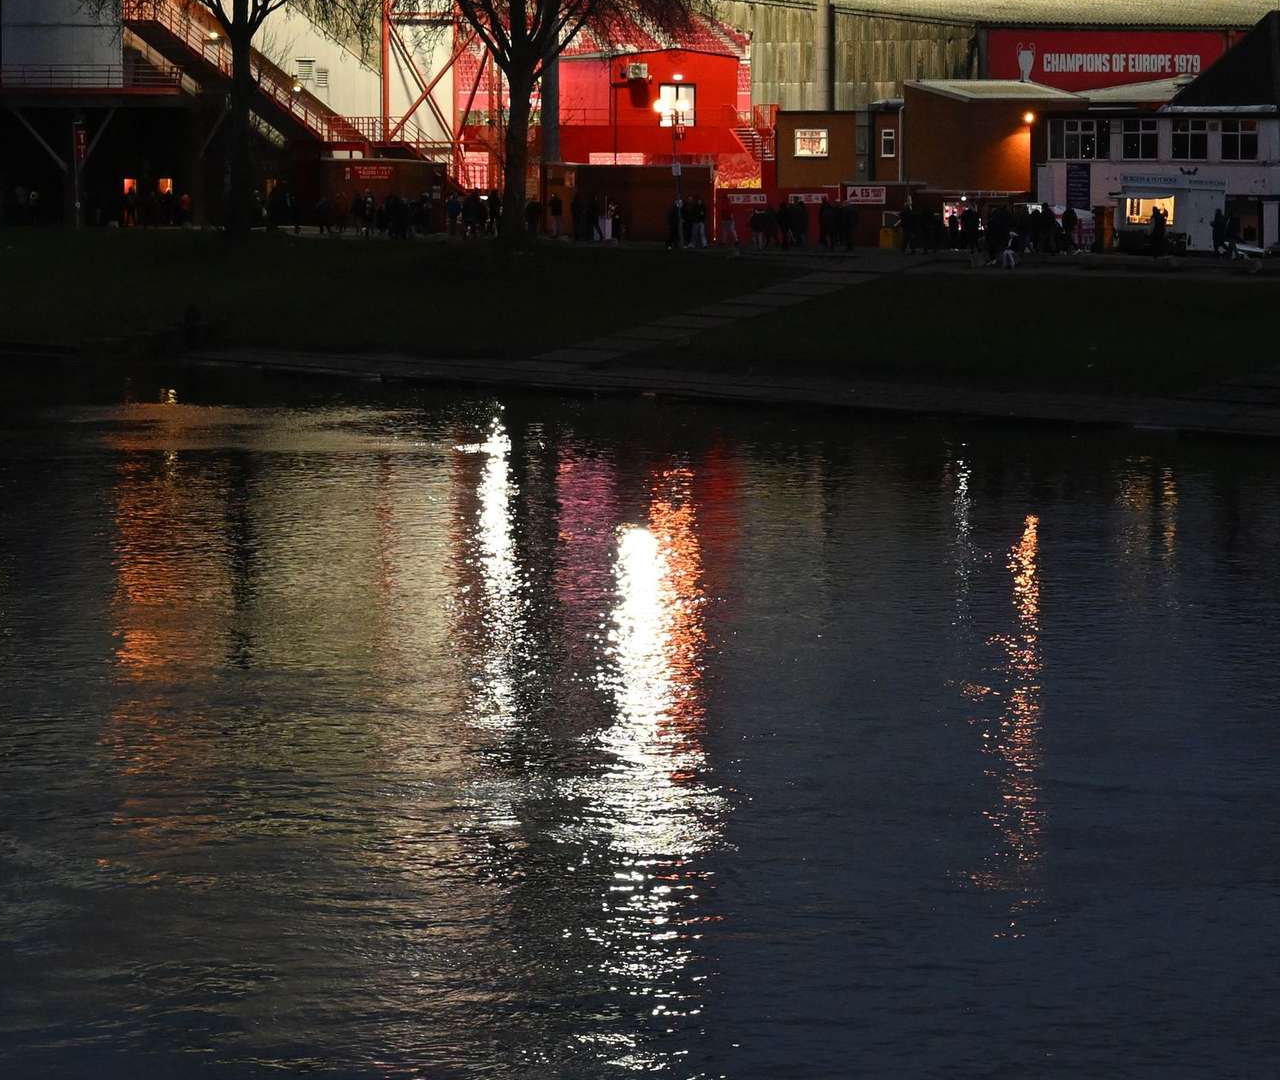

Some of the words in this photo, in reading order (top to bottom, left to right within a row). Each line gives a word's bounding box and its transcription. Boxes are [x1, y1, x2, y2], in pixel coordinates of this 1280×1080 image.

[1043, 53, 1110, 72] CHAMPIONS
[1112, 53, 1127, 72] OF
[1128, 53, 1172, 72] EUROPE
[1173, 54, 1201, 73] 1979
